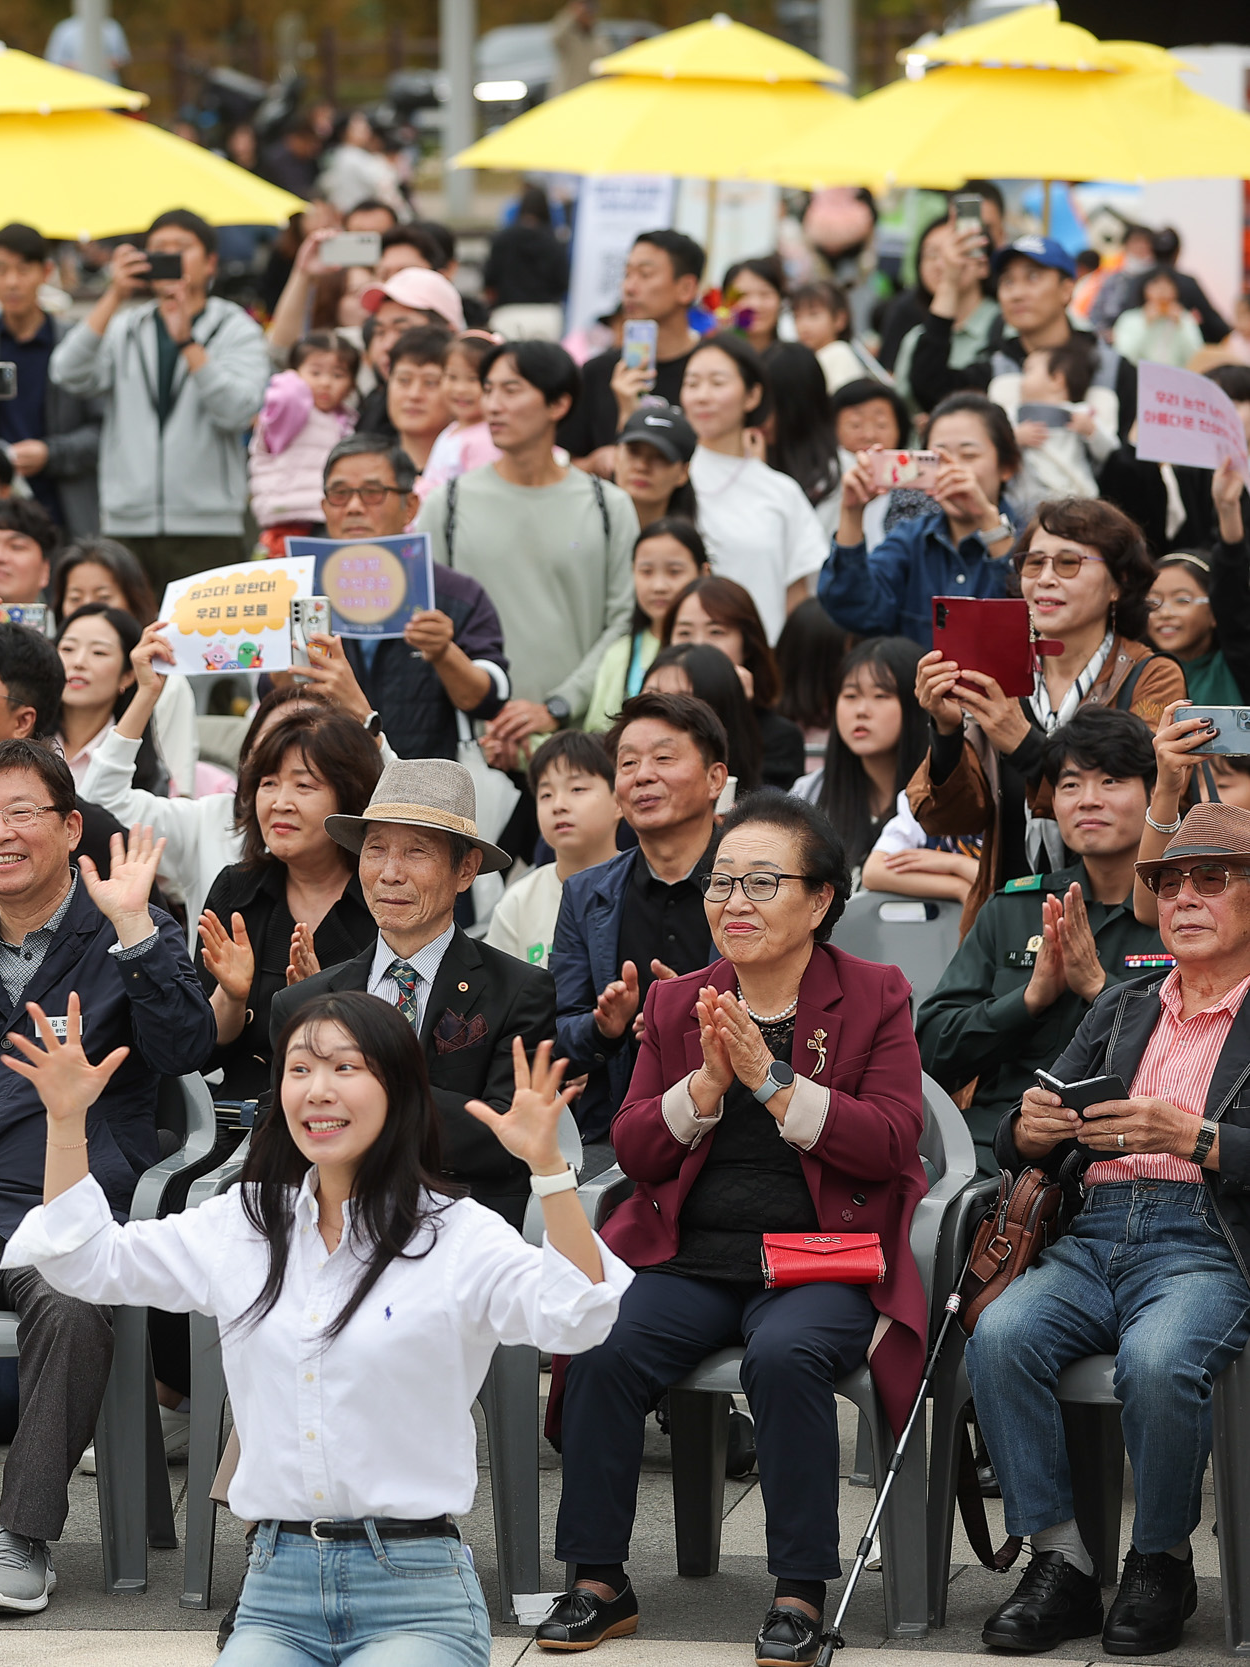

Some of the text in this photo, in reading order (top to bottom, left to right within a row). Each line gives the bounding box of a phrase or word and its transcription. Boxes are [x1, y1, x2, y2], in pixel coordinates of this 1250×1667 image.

[190, 581, 276, 600] 최고다! 잘한다!
[197, 604, 268, 619] 우리 집 보물
